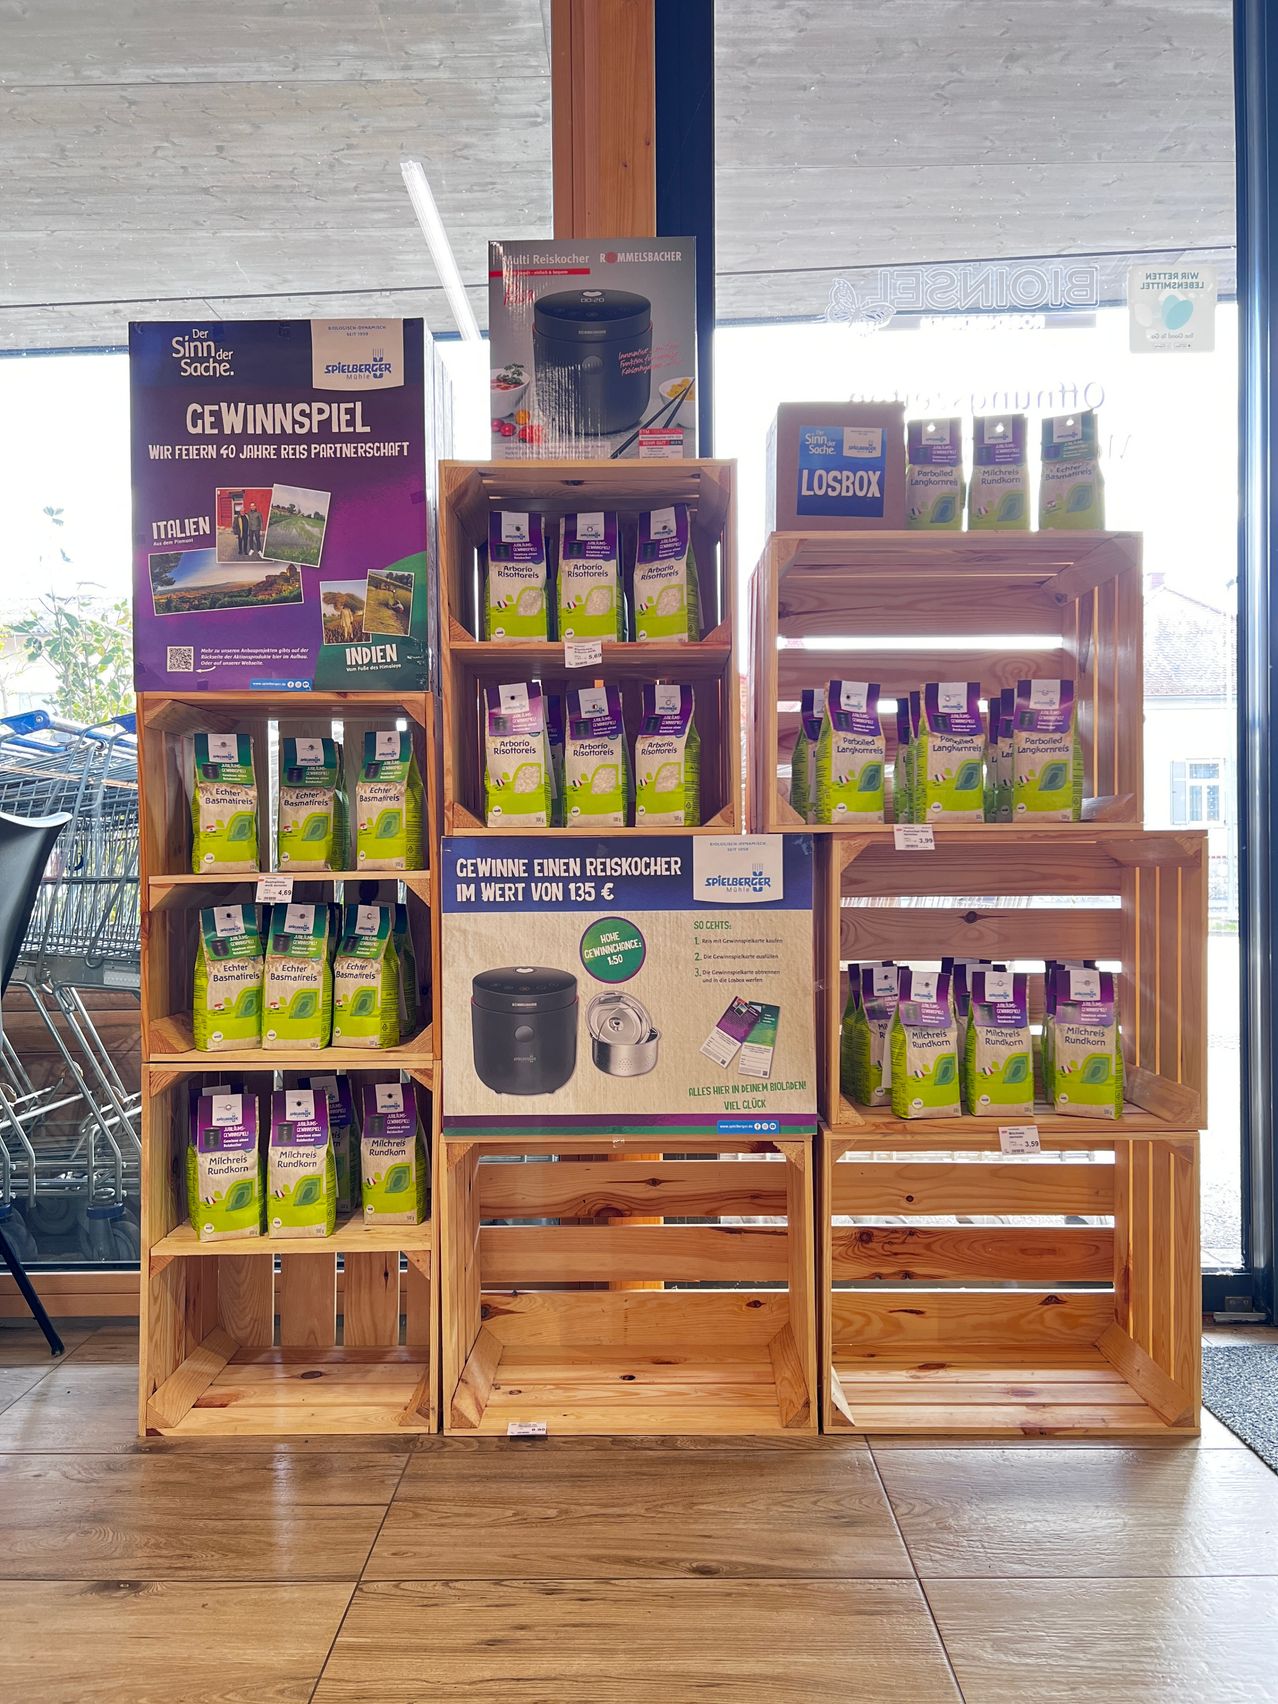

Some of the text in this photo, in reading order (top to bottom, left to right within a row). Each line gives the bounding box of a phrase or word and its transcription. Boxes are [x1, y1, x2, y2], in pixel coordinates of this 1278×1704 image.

[502, 252, 590, 265] Multi Reiskocher
[599, 250, 682, 264] ROMMELSBACHER
[192, 328, 209, 339] Der
[171, 336, 215, 358] Sinn
[215, 349, 234, 360] der
[180, 359, 235, 378] Sache.
[324, 361, 392, 374] SPIELBERGER
[186, 402, 371, 435] GEWINNSPIEL
[805, 432, 828, 445] Sinn
[149, 442, 410, 460] WIR FEIERN 40 JAHRE REIS PARTNERSCHAFT
[1056, 464, 1082, 473] Echter
[917, 470, 953, 478] Parboiled
[1045, 469, 1092, 481] Basmatireis
[802, 469, 881, 497] LOSBOX
[981, 477, 1021, 485] Rundkorn
[152, 516, 210, 539] ITALIEN
[503, 565, 533, 573] Arborio
[573, 563, 603, 571] Arborio
[647, 564, 674, 574] Arborio
[497, 571, 540, 579] Risottoreis
[567, 570, 609, 578] Risottoreis
[640, 569, 679, 580] Risottoreis
[346, 644, 398, 665] INDIEN
[500, 740, 530, 748] Arborio
[647, 741, 674, 749] Arborio
[842, 737, 875, 745] Parboiled
[1024, 737, 1063, 745] Parboiled
[494, 747, 536, 755] Risottoreis
[573, 749, 614, 757] Risottoreis
[641, 746, 678, 756] Risottoreis
[837, 746, 883, 755] Langkornreis
[932, 745, 982, 753] Langkornreis
[1017, 745, 1069, 755] Langkornreis
[215, 788, 241, 797] Echter
[369, 786, 392, 794] Echter
[205, 797, 253, 805] Basmatireis
[360, 795, 400, 803] Basmatireis
[457, 857, 681, 878] GEWINNE EINEN REISKOCHER
[705, 875, 771, 888] SPIELBERGER
[456, 882, 614, 902] IM WERT VON 135 €
[693, 920, 704, 930] SO
[600, 931, 620, 943] HOHE
[584, 938, 642, 959] GEWINNCHANCE:
[607, 954, 624, 965] 1:50
[694, 952, 702, 961] 2.
[223, 964, 248, 972] Echter
[282, 964, 307, 972] Echter
[694, 968, 701, 977] 3.
[213, 972, 260, 982] Basmatireis
[270, 973, 317, 982] Basmatireis
[336, 971, 376, 979] Basmatireis
[912, 1030, 947, 1039] Milchreis
[985, 1029, 1020, 1038] Milchreis
[1066, 1027, 1105, 1037] Milchreis
[912, 1039, 951, 1049] Rundkorn
[985, 1038, 1023, 1046] Rundkorn
[1064, 1036, 1106, 1046] Rundkorn
[688, 1080, 807, 1097] ALLES HIER IN DEINEM BIOLADEN!
[724, 1097, 766, 1110] VIEL GLÜCK
[371, 1139, 406, 1147] Milchreis
[280, 1150, 317, 1159] Milchreis
[369, 1148, 406, 1156] Rundkorn
[209, 1155, 248, 1166] Milchreis
[277, 1160, 317, 1168] Rundkorn
[207, 1166, 249, 1175] Rundkorn
